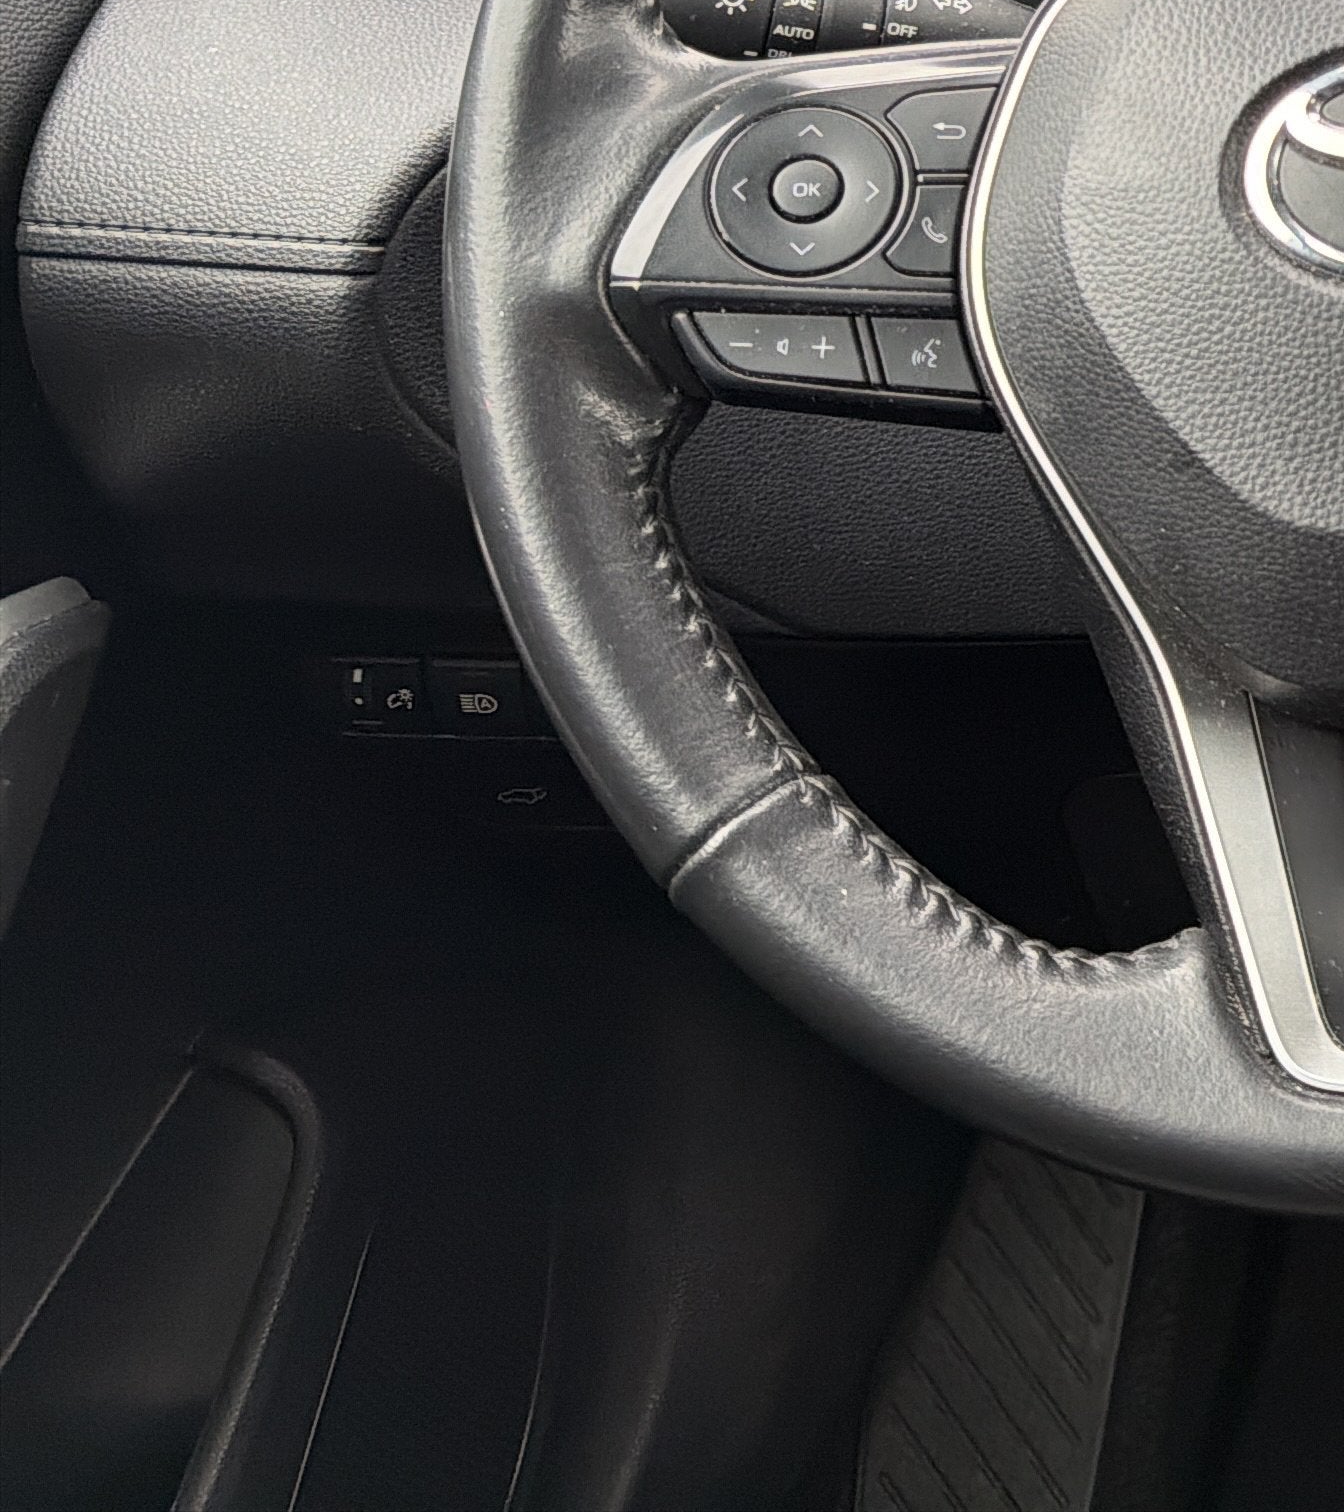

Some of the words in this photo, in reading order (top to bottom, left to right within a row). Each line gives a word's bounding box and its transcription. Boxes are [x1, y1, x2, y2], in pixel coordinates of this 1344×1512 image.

[772, 24, 815, 41] AUTO
[887, 21, 919, 38] OFF
[791, 182, 821, 197] OK
